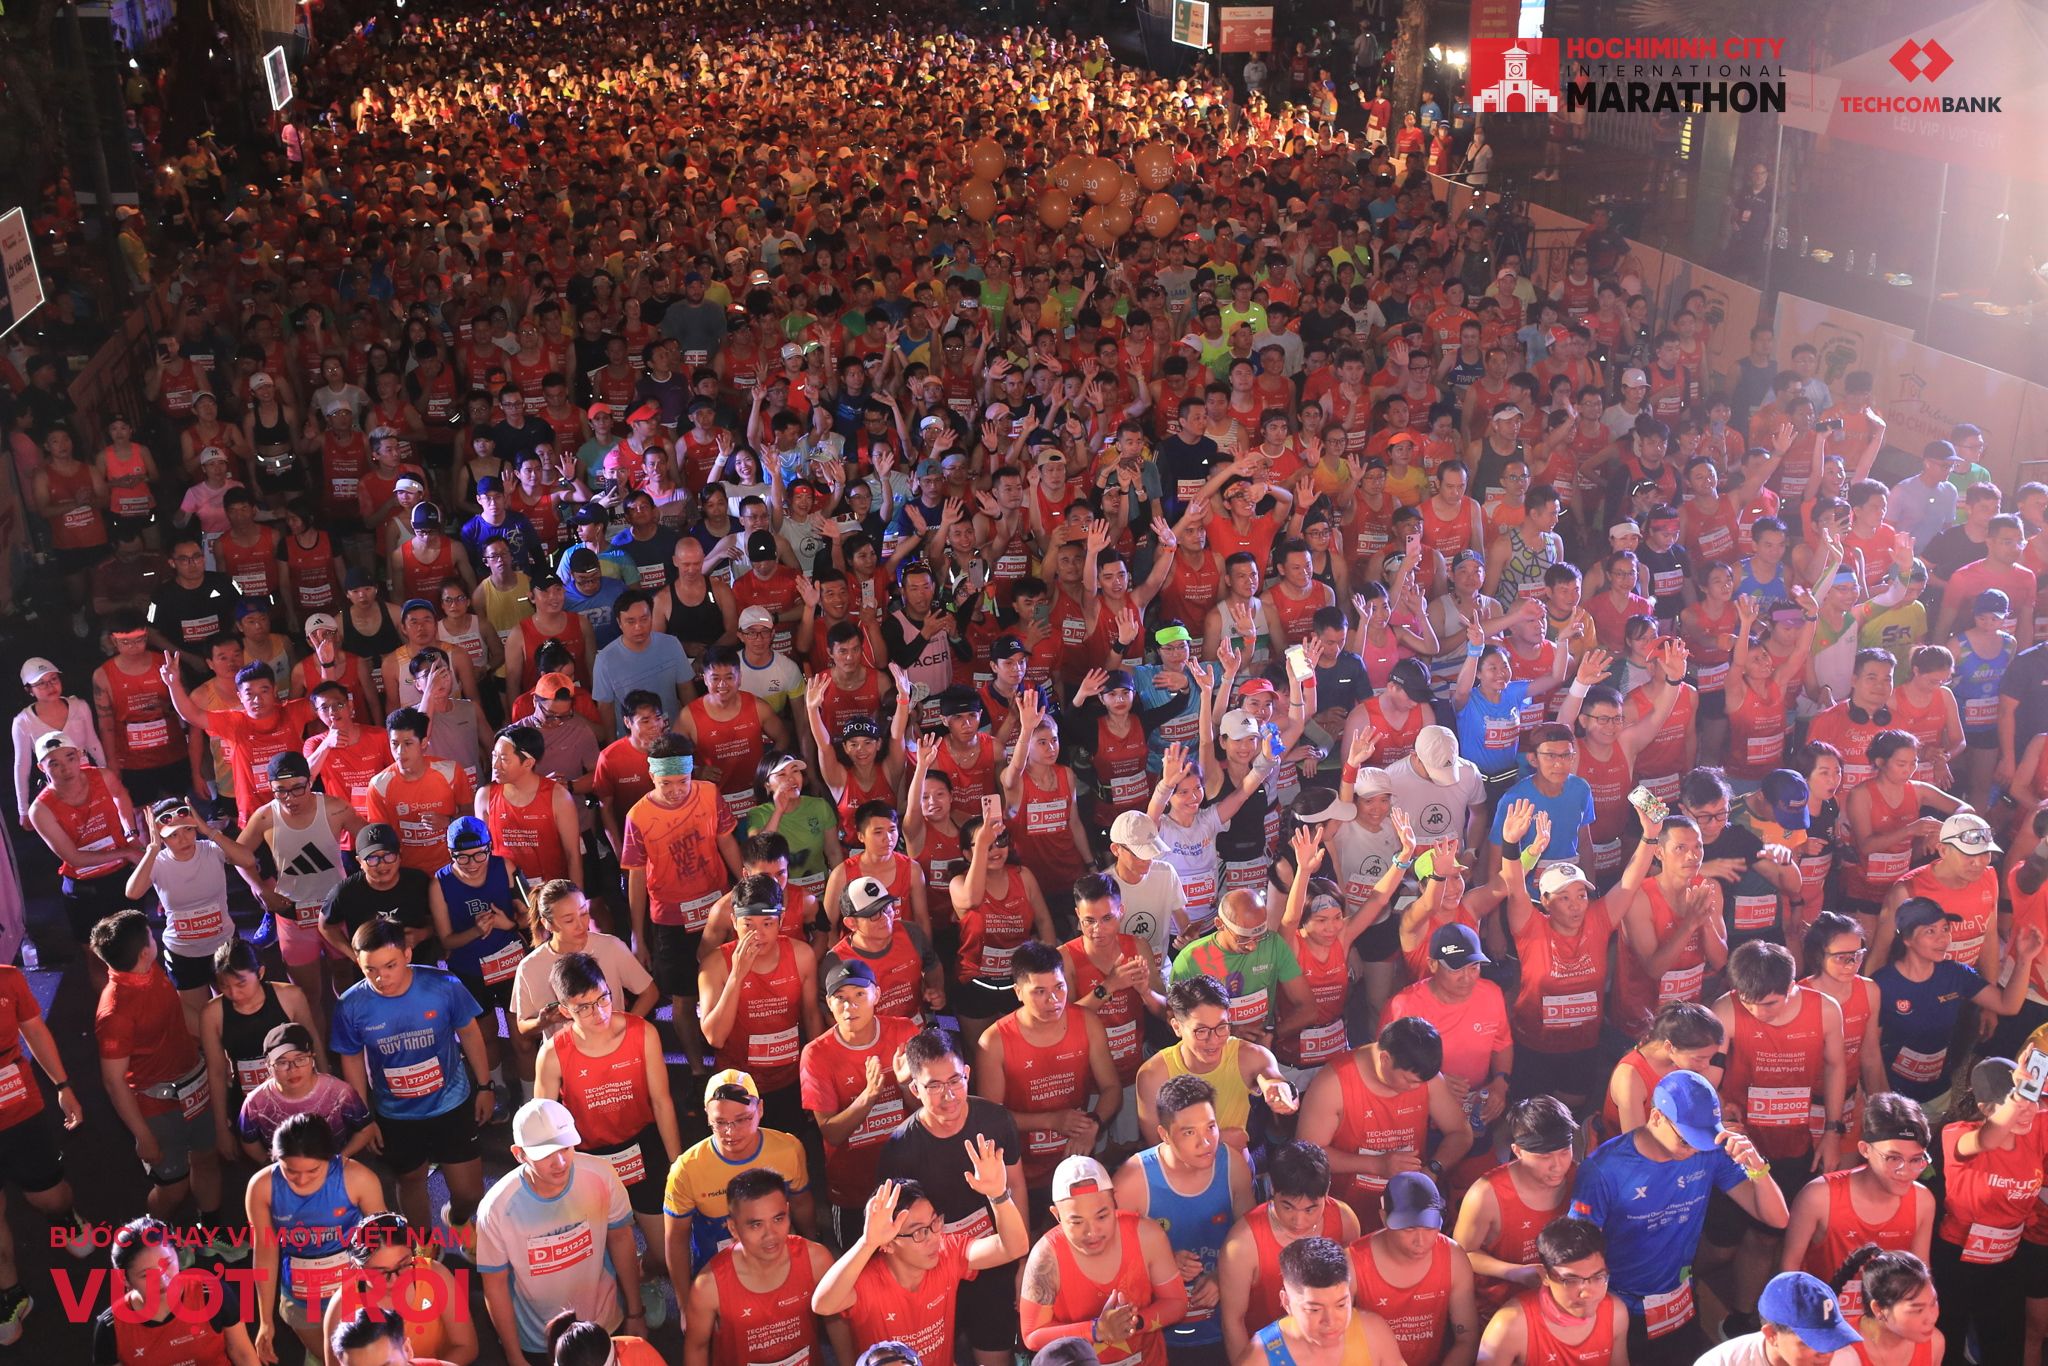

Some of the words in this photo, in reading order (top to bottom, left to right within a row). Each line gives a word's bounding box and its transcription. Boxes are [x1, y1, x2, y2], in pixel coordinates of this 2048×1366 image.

[1178, 3, 1185, 21] C
[1919, 119, 1940, 137] VIP
[1151, 166, 1174, 178] 2:30
[914, 652, 949, 668] ACER
[843, 721, 877, 736] SPORT
[717, 748, 750, 759] MARATHON
[1848, 774, 1855, 783] D
[411, 802, 443, 812] Shopee
[1031, 812, 1039, 821] D
[934, 871, 943, 879] D
[1231, 872, 1239, 880] D
[1351, 885, 1357, 893] D
[302, 909, 310, 917] D
[687, 911, 696, 921] E
[178, 921, 187, 929] D
[986, 958, 994, 966] C
[1550, 967, 1596, 978] MARATHON
[1664, 984, 1675, 992] D
[748, 997, 788, 1005] TECHCOMBANK
[749, 1008, 787, 1018] MARATHON
[1238, 1003, 1266, 1017] 200317
[1548, 1007, 1558, 1016] D
[1564, 1006, 1597, 1015] 332093
[769, 1041, 798, 1053] 200980
[1306, 1041, 1316, 1051] D
[1900, 1058, 1910, 1067] E
[244, 1072, 252, 1081] E
[391, 1077, 402, 1087] C
[408, 1069, 440, 1085] 372069
[1029, 1072, 1075, 1085] TECHCOMBANK
[584, 1080, 632, 1094] TECHCOMBANK
[1032, 1086, 1075, 1101] MARATHON
[185, 1096, 194, 1108] D
[588, 1094, 633, 1109] MARATHON
[1754, 1101, 1765, 1111] D
[1771, 1101, 1808, 1111] 382002
[869, 1115, 903, 1129] 200313
[1035, 1131, 1046, 1142] D
[1366, 1128, 1414, 1137] TECHCOMBANK
[534, 1250, 546, 1261] D
[555, 1235, 590, 1256] 841222
[1973, 1238, 1985, 1249] A
[1839, 1296, 1850, 1306] D
[1823, 1299, 1834, 1320] P
[1386, 1313, 1432, 1325] CHCOMBANK
[747, 1316, 800, 1335] TECHCOMBANK
[788, 1321, 800, 1329] CITY
[892, 1317, 944, 1341] TECHCOMBANK
[917, 1333, 932, 1343] MINH
[934, 1323, 944, 1334] CITY
[1395, 1331, 1433, 1341] RATHON
[749, 1330, 801, 1352] MARATHON
[918, 1335, 944, 1357] ATHON
